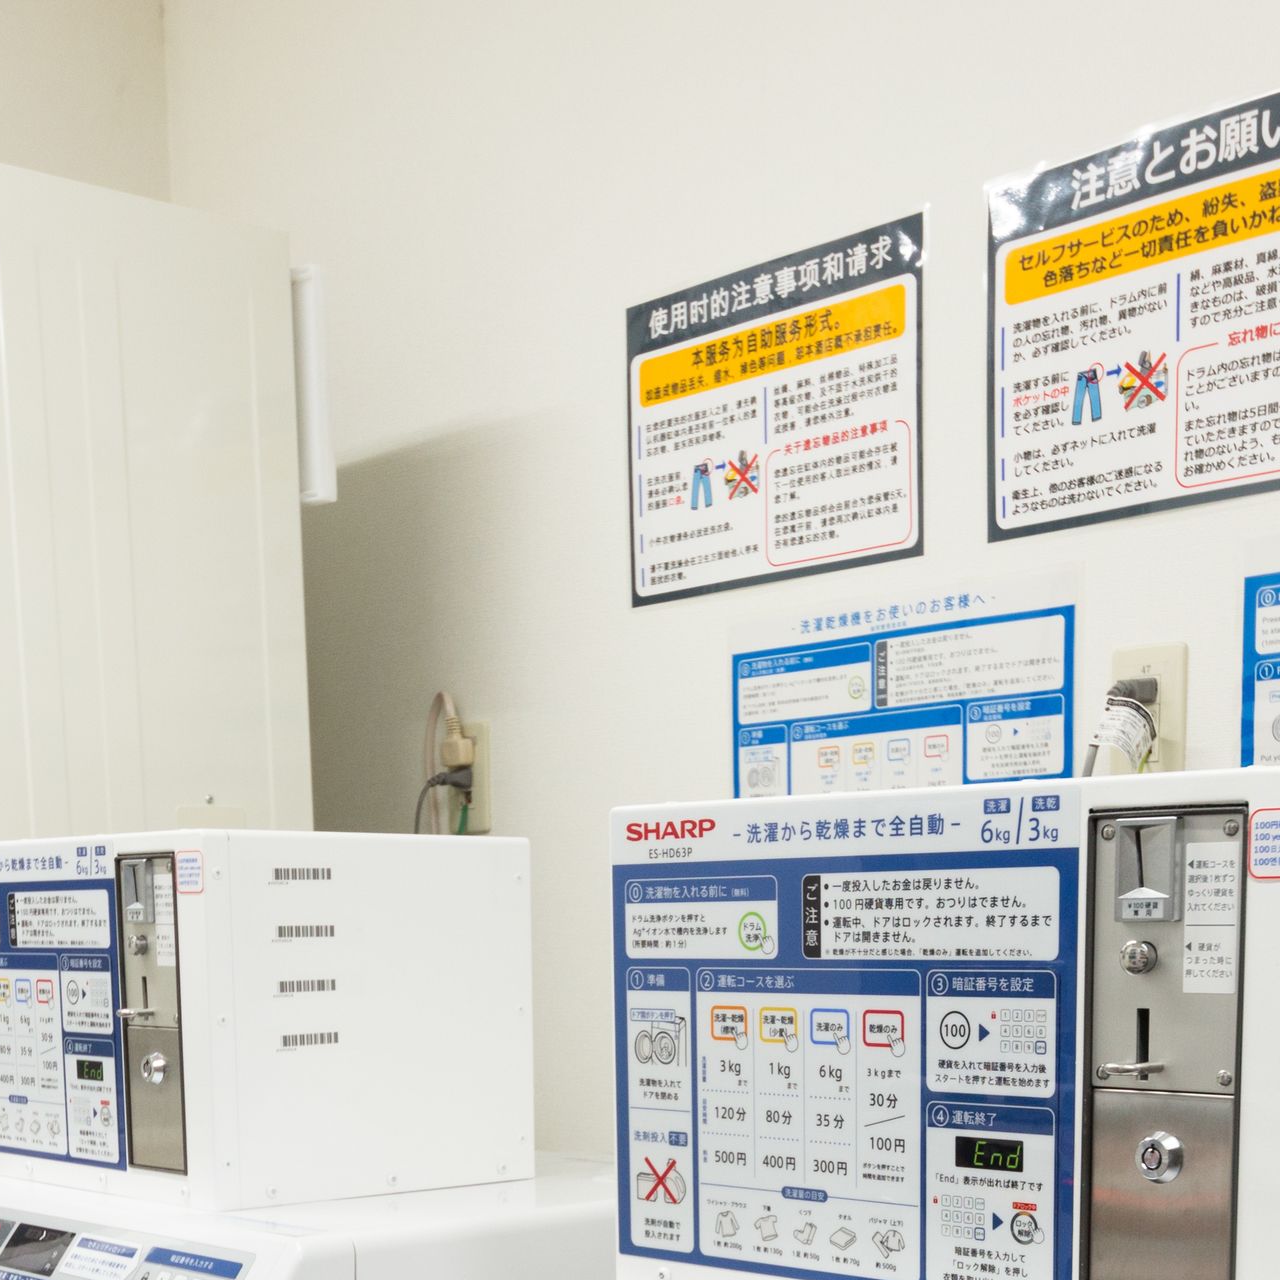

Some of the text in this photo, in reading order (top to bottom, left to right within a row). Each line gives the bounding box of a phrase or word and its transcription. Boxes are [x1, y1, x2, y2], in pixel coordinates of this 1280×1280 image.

[649, 236, 892, 338] 使用时的注意事项和请求
[627, 819, 715, 841] SHARP
[747, 813, 944, 843] 洗濯から乾燥まで全自動
[1255, 833, 1269, 841] 100
[649, 848, 692, 859] ES-HD63P
[645, 884, 729, 900] 洗濯物を入れる前に
[833, 878, 978, 892] 一度投入したお金は戻りません。
[835, 931, 914, 943] ドアは開きません。
[718, 975, 794, 988] 運転コースを選ぶ
[952, 976, 1035, 994] 暗証番号を設定
[951, 1110, 998, 1127] 運転終了
[974, 1140, 1022, 1168] End
